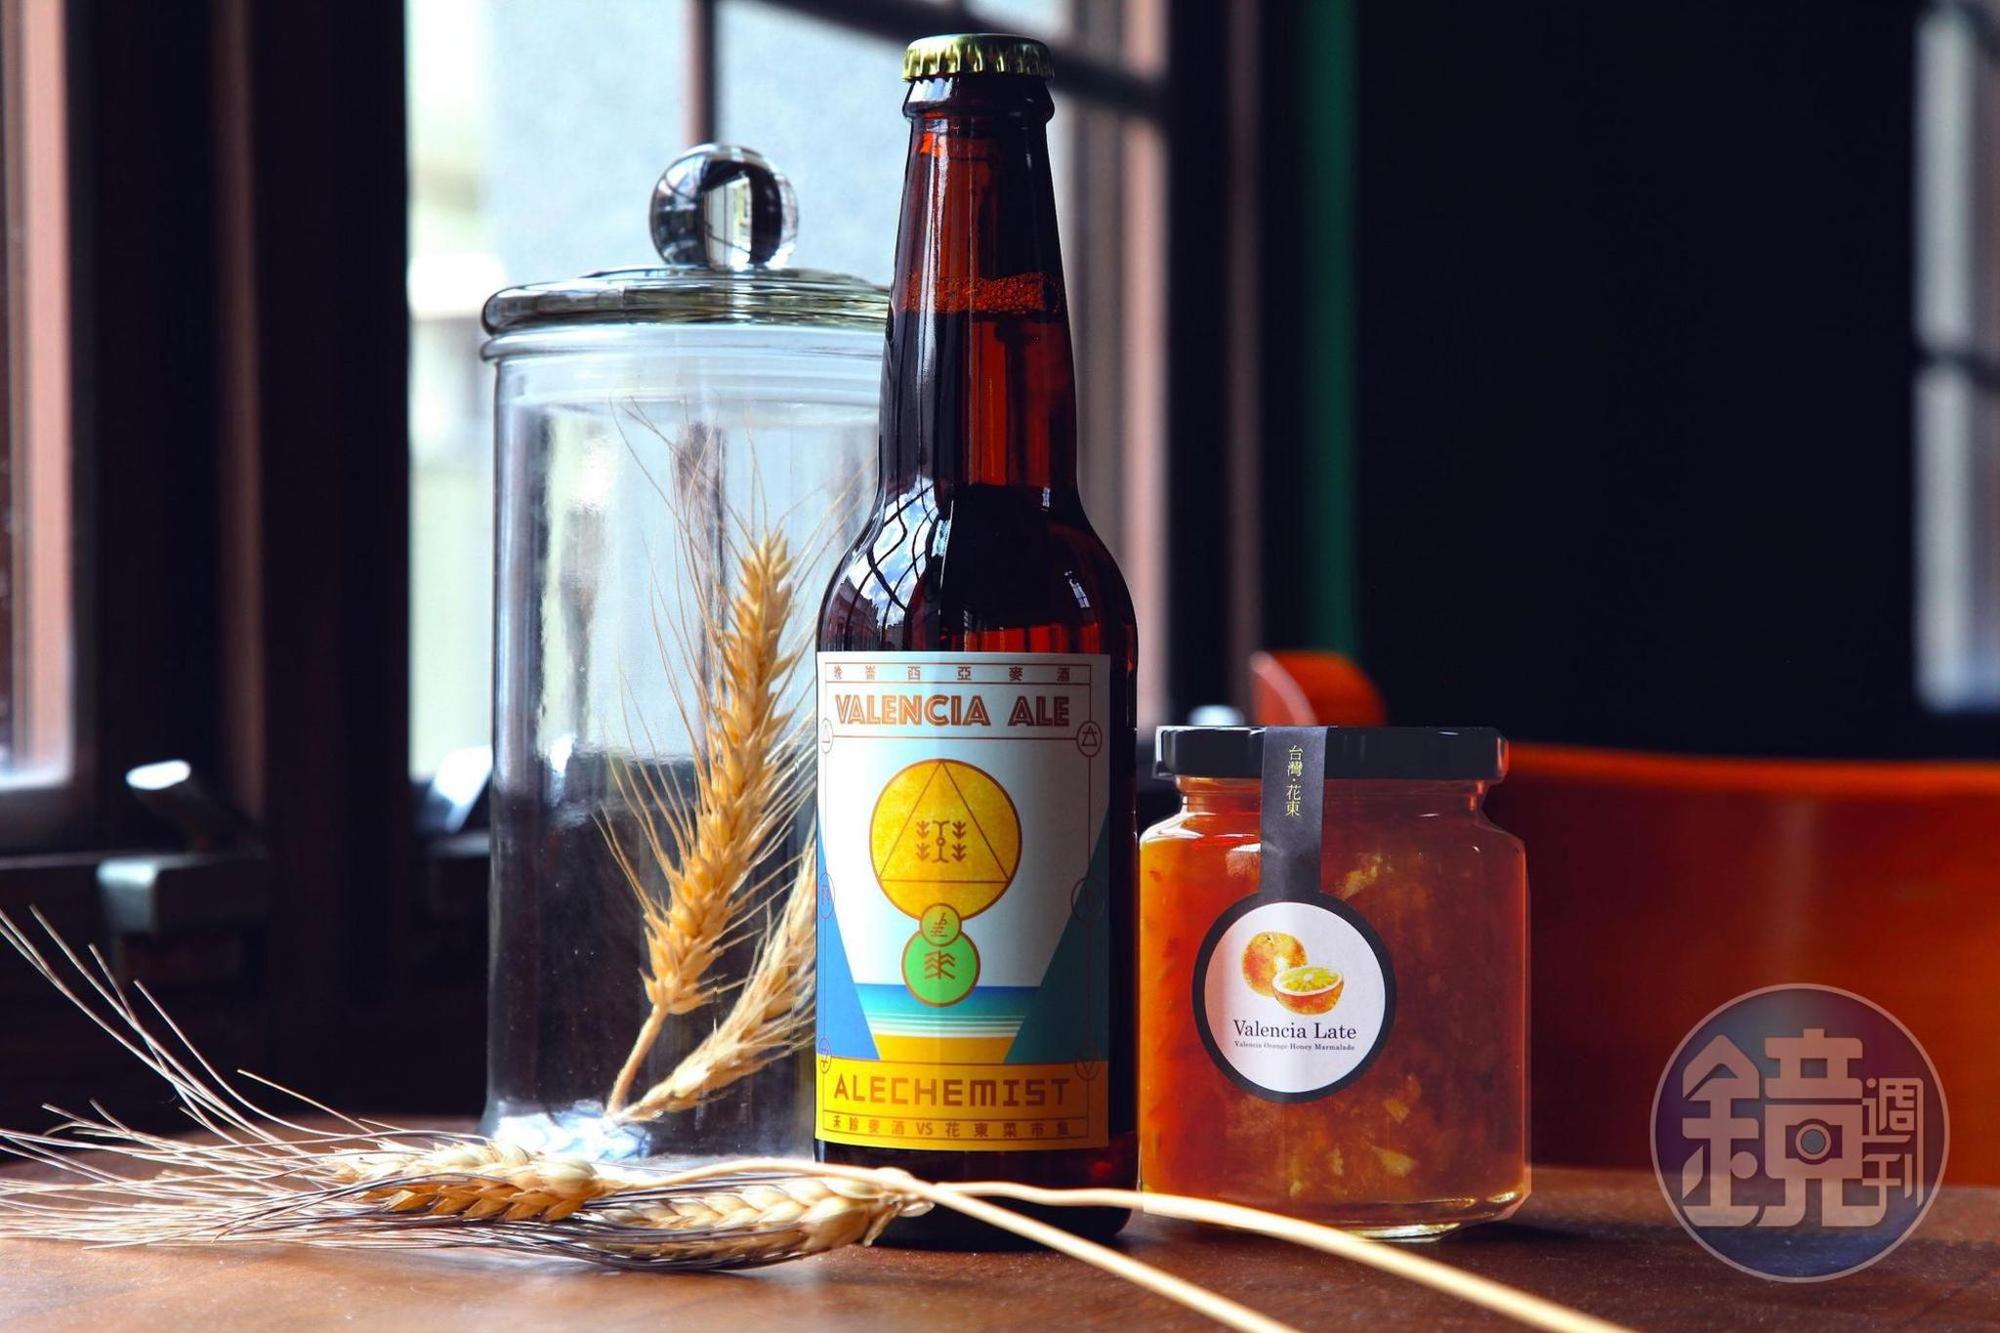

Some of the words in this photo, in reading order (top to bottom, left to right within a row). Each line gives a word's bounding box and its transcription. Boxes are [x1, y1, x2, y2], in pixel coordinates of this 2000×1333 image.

[835, 694, 991, 726] VALENCIA
[1008, 695, 1070, 727] ALE
[1233, 1019, 1307, 1039] Valencia
[1314, 1022, 1357, 1040] Late
[1234, 1040, 1263, 1048] Valencia
[1290, 1043, 1313, 1051] Honey
[1314, 1043, 1356, 1051] Marmalade
[834, 1073, 1070, 1107] ALECHEMIST
